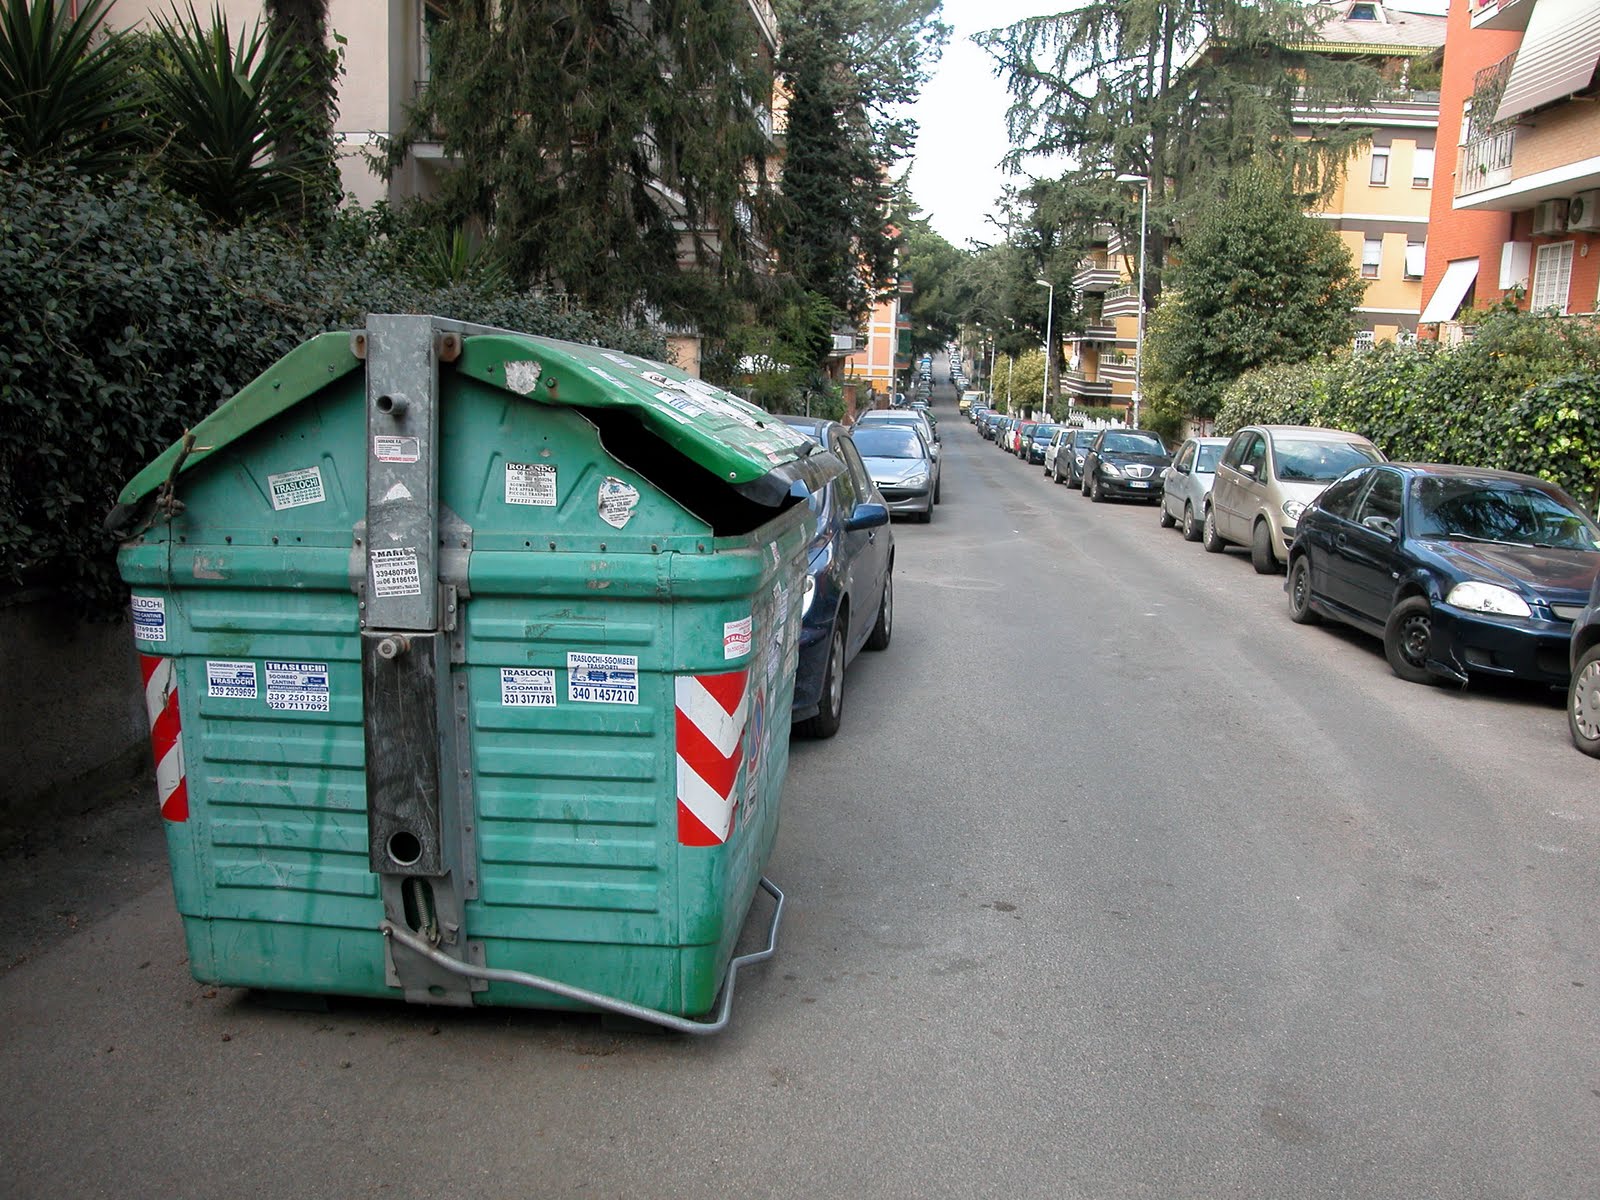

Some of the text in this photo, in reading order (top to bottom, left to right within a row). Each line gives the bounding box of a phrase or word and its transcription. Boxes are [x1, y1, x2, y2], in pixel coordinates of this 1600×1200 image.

[509, 463, 556, 472] ROLANDO
[274, 478, 319, 494] TRASLOCHI
[376, 568, 416, 577] 3394807969
[570, 654, 636, 666] TRASLOCHI-SGOMBERI
[267, 663, 326, 672] TRASLOCHI
[503, 669, 553, 677] TRASLOCHI
[213, 678, 253, 686] TRASLOCHI
[211, 687, 256, 697] 339 2939692
[572, 687, 635, 702] 340 1457210
[268, 693, 328, 703] 339 2501353
[504, 694, 555, 704] 331 3171781
[288, 702, 328, 711] 7117092
